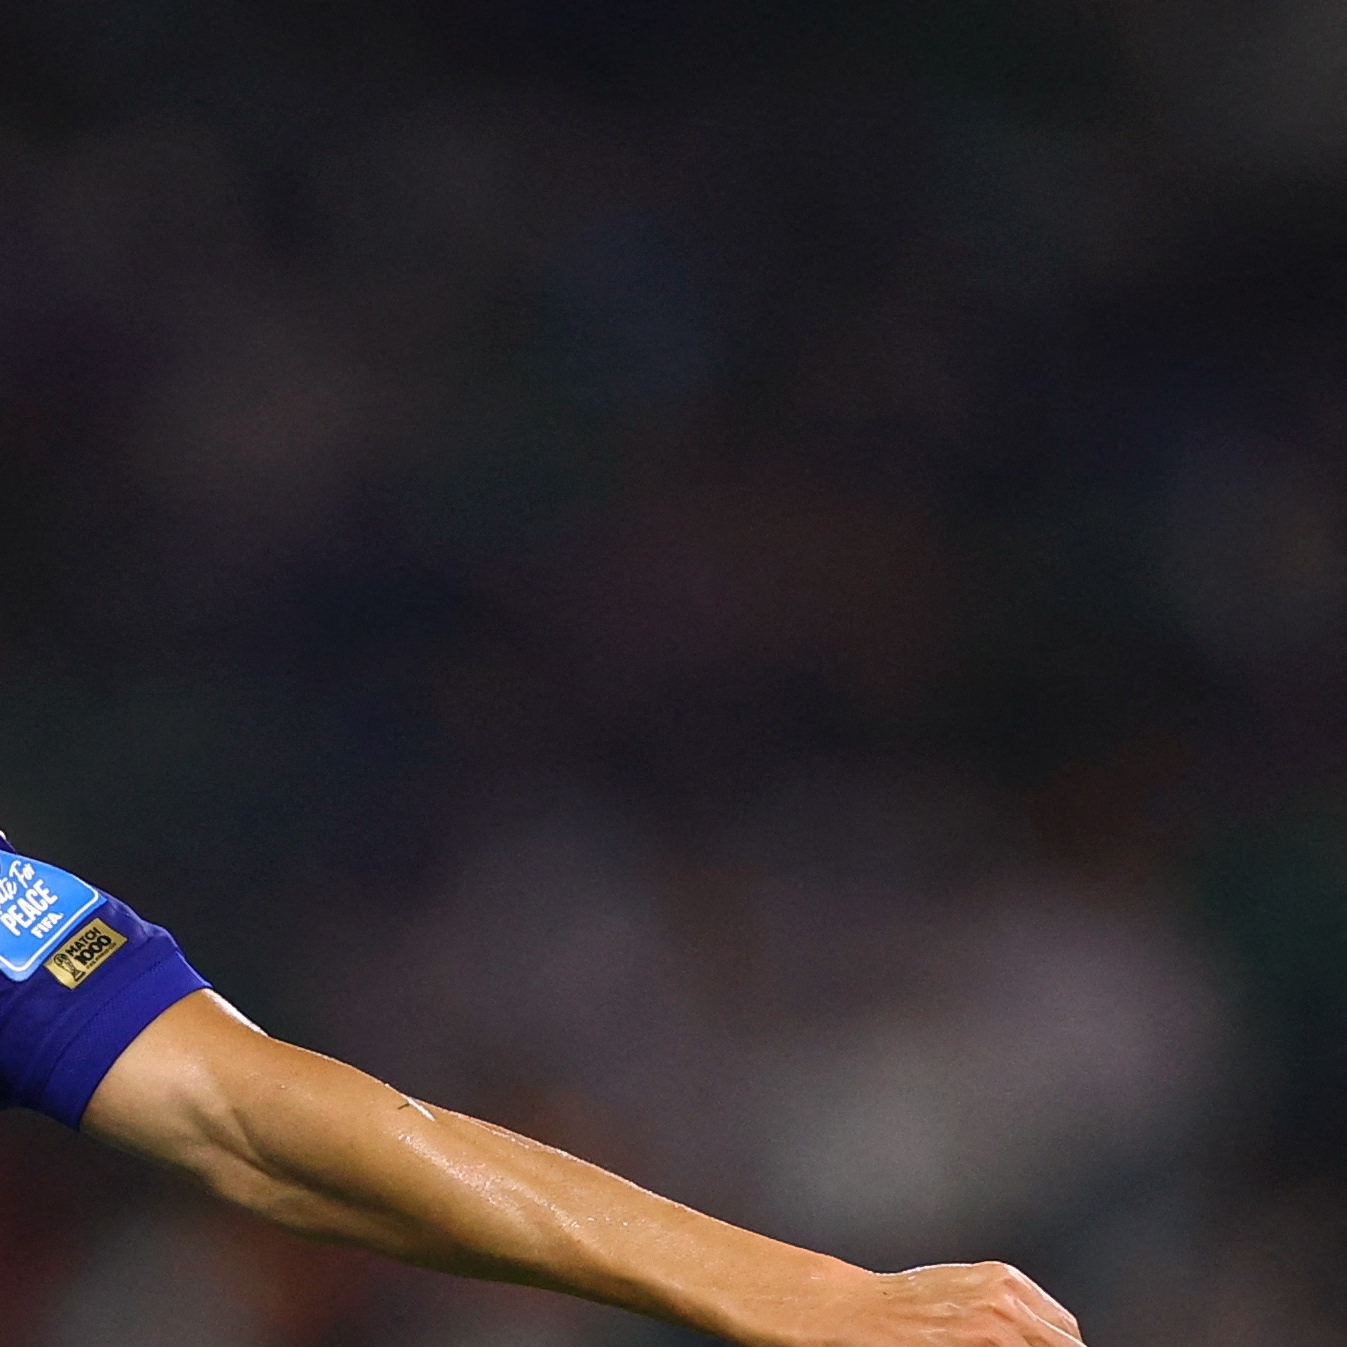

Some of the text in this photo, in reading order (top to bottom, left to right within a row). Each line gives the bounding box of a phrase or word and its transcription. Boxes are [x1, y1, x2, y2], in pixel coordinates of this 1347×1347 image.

[0, 879, 59, 937] PEACE
[30, 912, 63, 939] FIFA
[65, 926, 102, 957] MATCH
[74, 935, 112, 966] 1000
